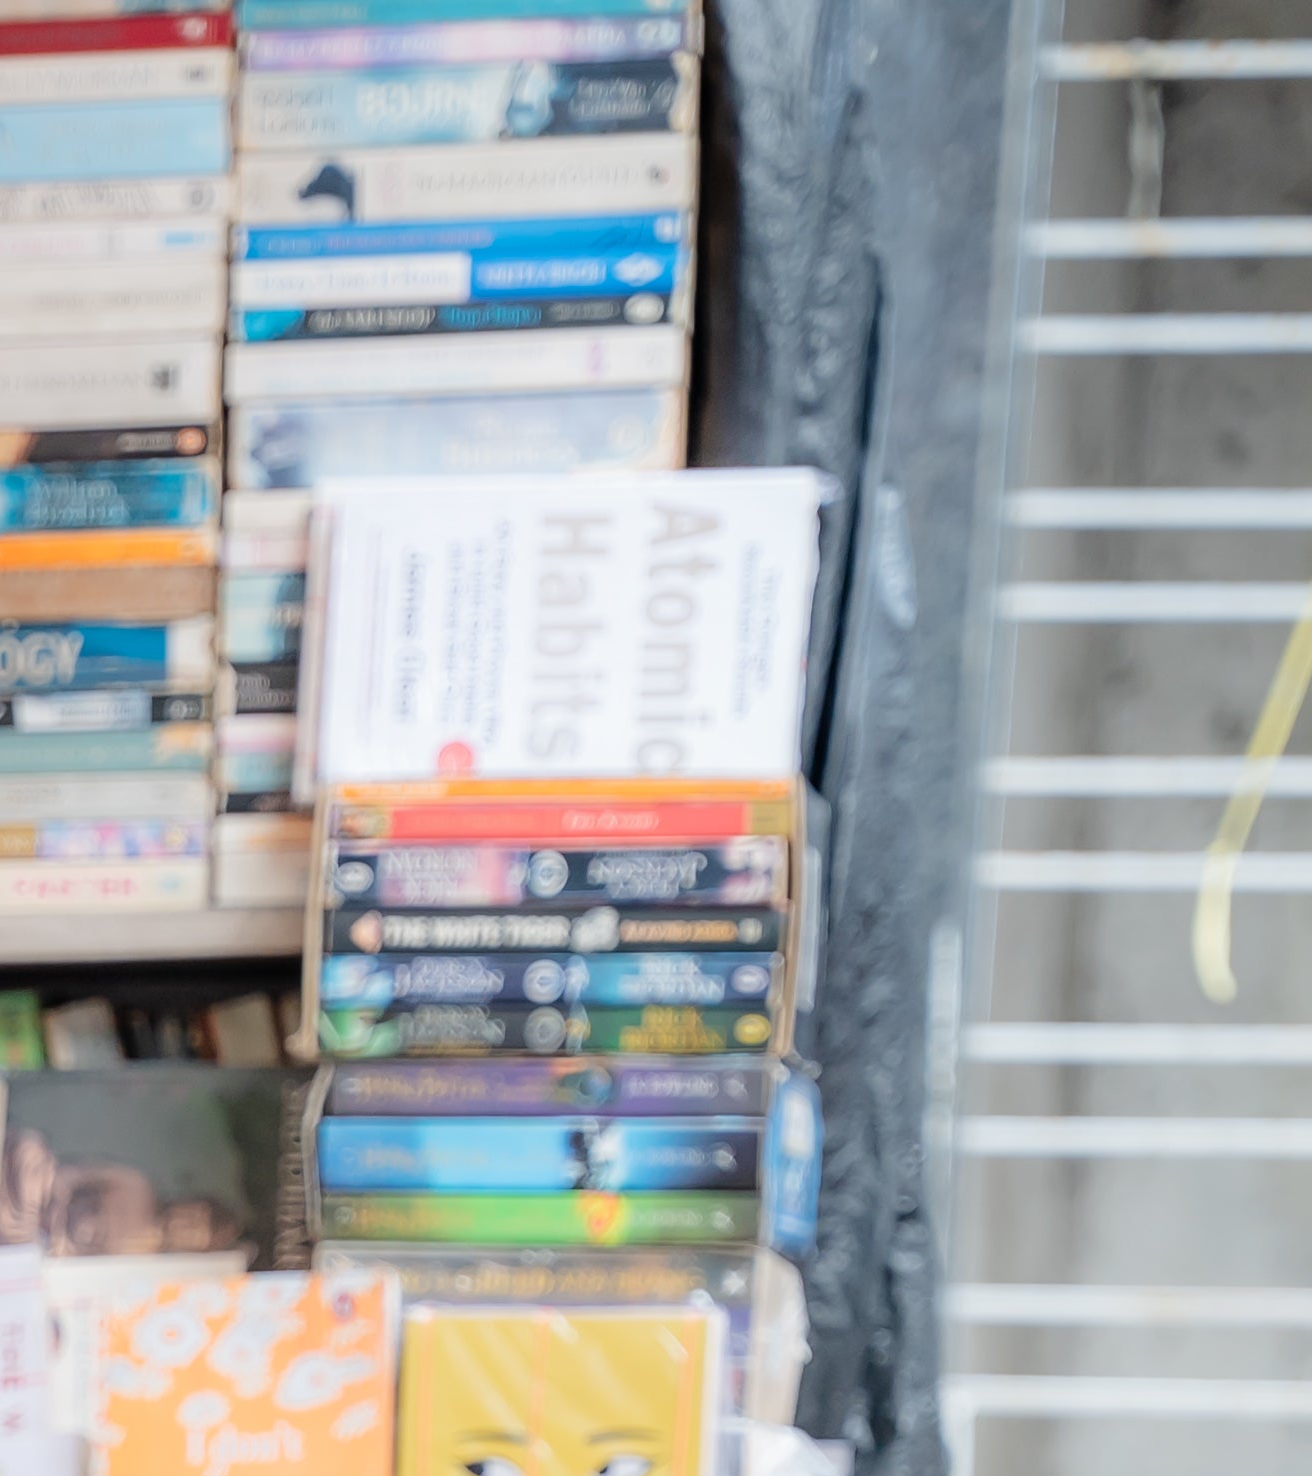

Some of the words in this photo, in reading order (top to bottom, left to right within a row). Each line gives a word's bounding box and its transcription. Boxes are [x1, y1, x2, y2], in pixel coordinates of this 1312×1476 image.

[525, 507, 618, 763] Habits
[633, 499, 727, 777] Atomic
[382, 917, 428, 949] THE
[431, 916, 499, 949] WHITE
[502, 914, 571, 947] TIGER
